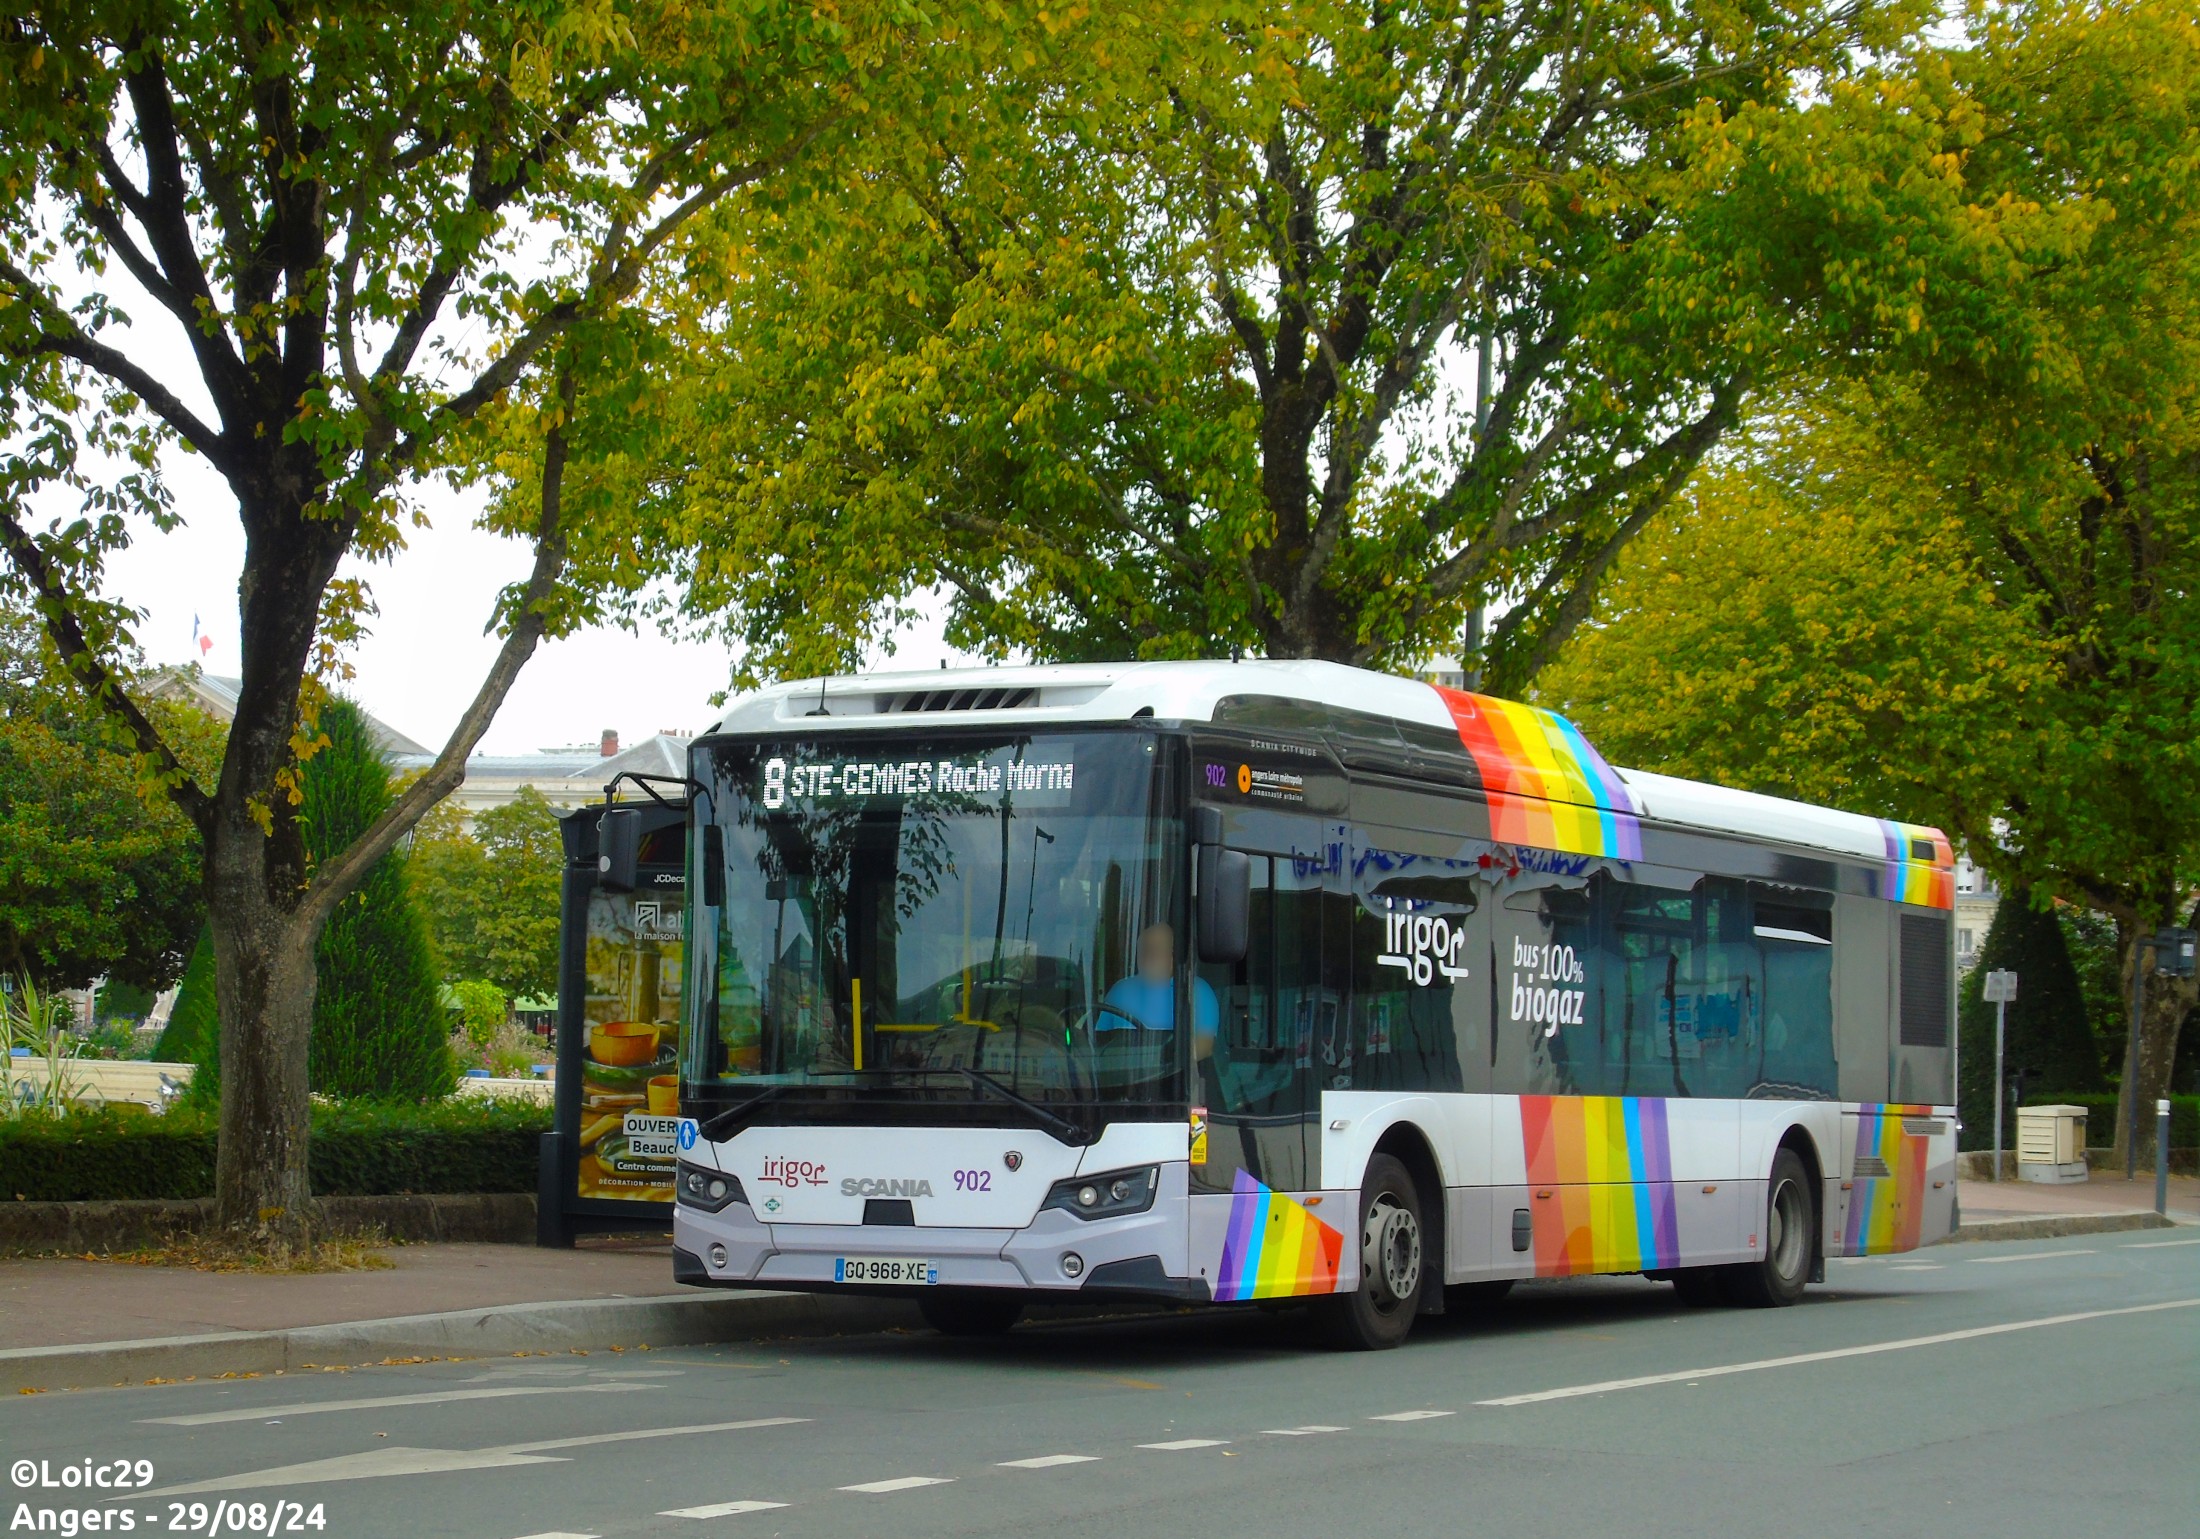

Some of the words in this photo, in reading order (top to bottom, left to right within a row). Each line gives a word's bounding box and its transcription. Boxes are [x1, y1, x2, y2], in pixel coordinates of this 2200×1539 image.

[1250, 739, 1278, 751] SCANIA
[1282, 744, 1317, 757] CITYWIDE
[763, 757, 787, 809] 8
[790, 761, 932, 797] STE-GEMMES
[936, 760, 1001, 793] Roche
[1006, 758, 1074, 791] Morna
[1205, 763, 1226, 787] 902
[634, 931, 642, 940] la
[644, 931, 676, 941] maison
[1513, 935, 1539, 968] bus
[1540, 943, 1584, 984] 100%
[1511, 972, 1585, 1038] biogaz
[633, 1140, 677, 1154] Beauc
[617, 1161, 645, 1171] Centre
[840, 1178, 934, 1198] SCANIA
[953, 1169, 991, 1192] 902
[845, 1261, 927, 1281] GQ-968-XE
